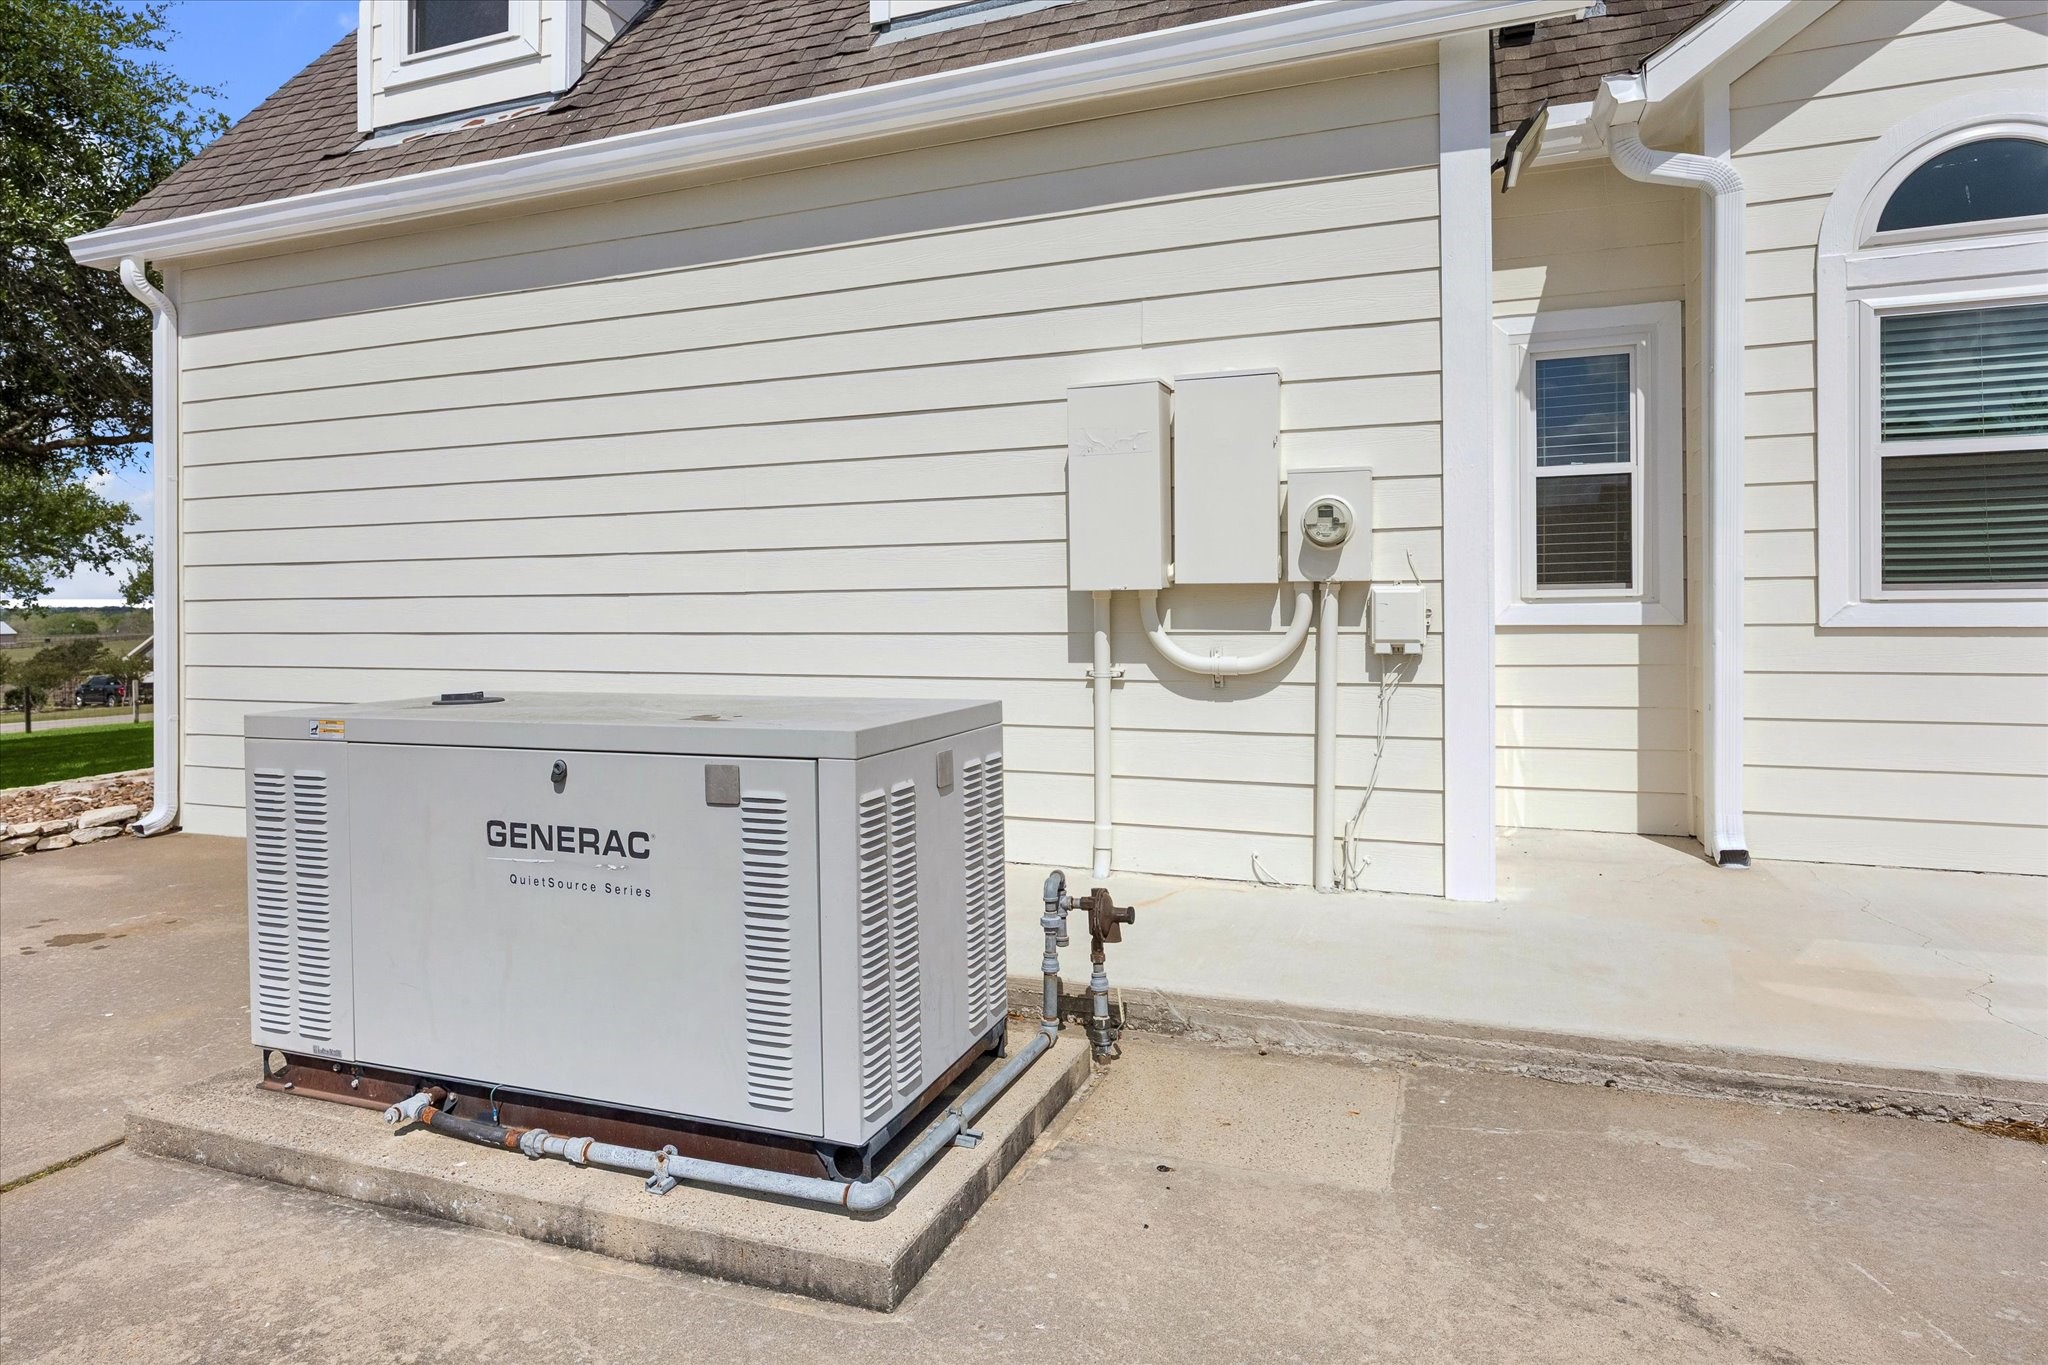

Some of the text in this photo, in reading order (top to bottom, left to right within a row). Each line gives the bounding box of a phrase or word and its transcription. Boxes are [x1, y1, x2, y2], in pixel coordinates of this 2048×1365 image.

[486, 820, 650, 860] GENERAC
[509, 873, 652, 898] QuietSource Series
